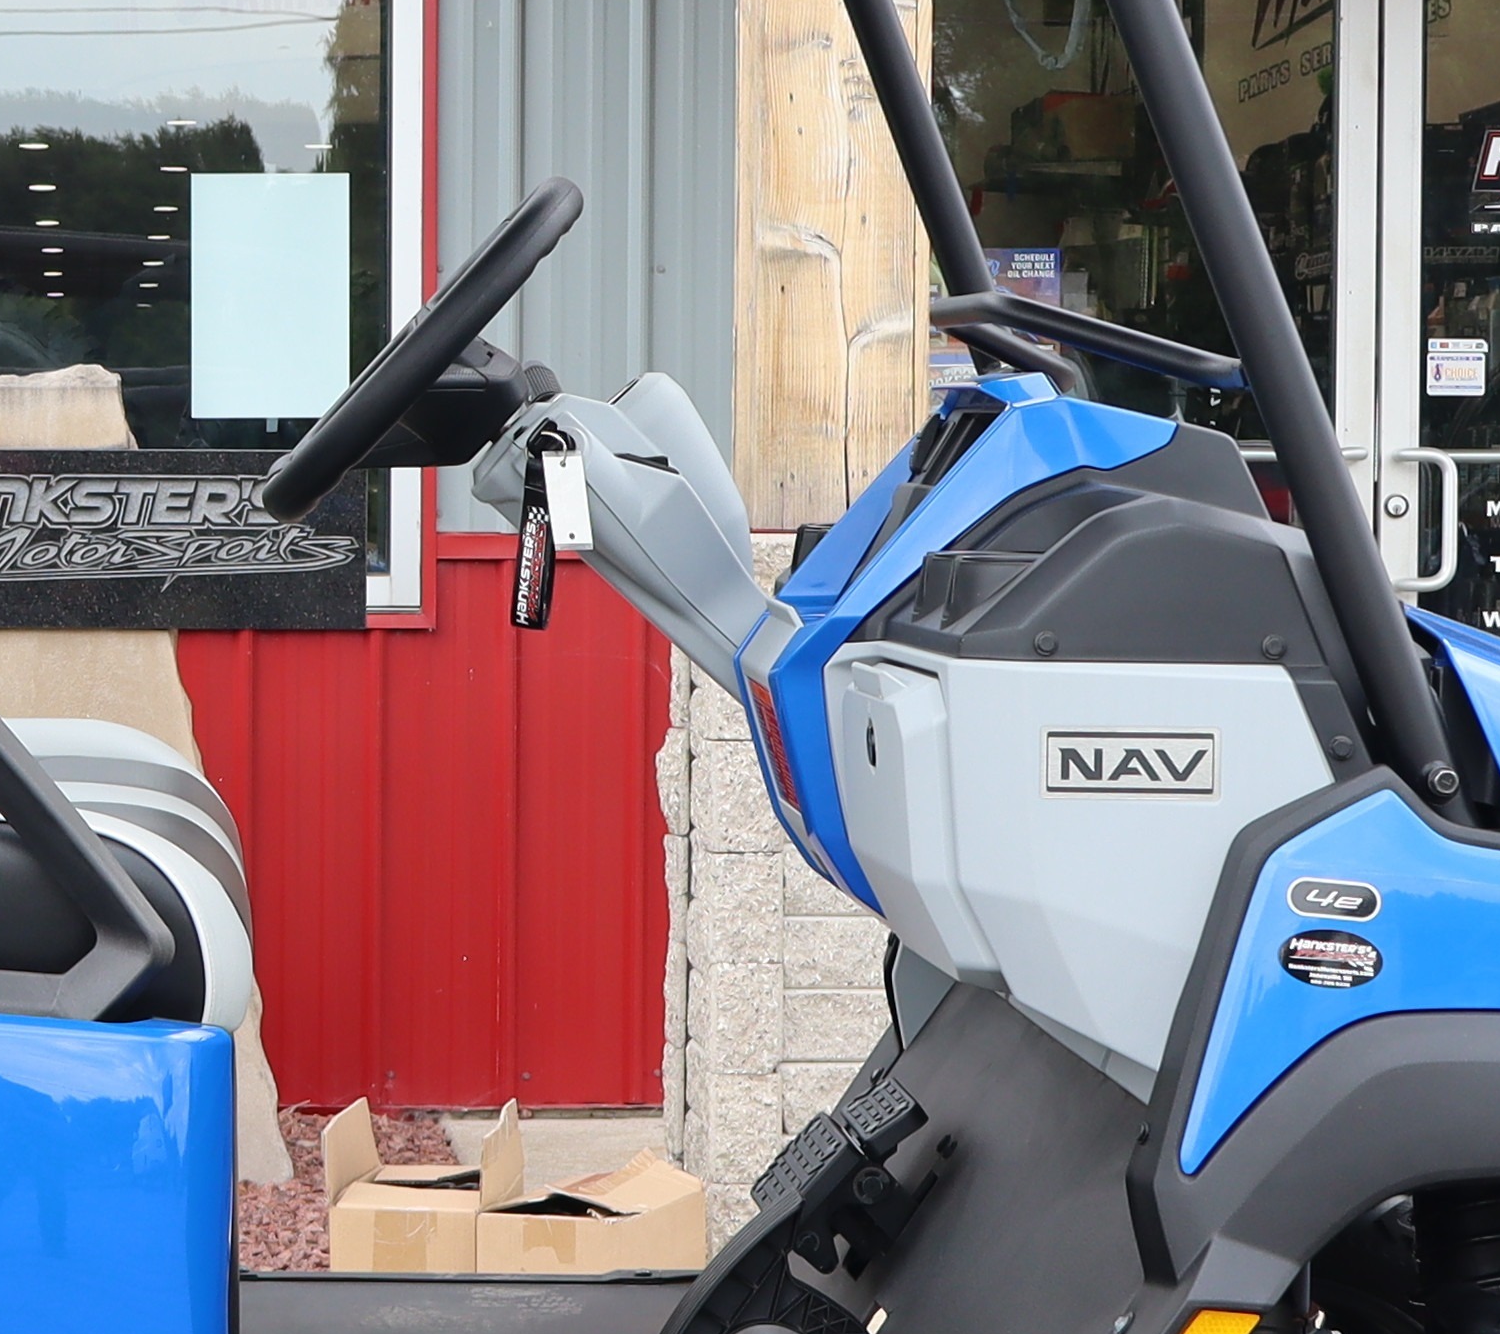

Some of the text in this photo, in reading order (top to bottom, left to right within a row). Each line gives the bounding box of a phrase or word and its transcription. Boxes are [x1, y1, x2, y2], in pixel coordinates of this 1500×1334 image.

[1239, 60, 1290, 103] PARTS
[1014, 253, 1055, 261] SCHEDULE
[1007, 270, 1055, 278] OIL CHANGE
[1058, 748, 1209, 782] NAV
[1306, 889, 1363, 909] 4e
